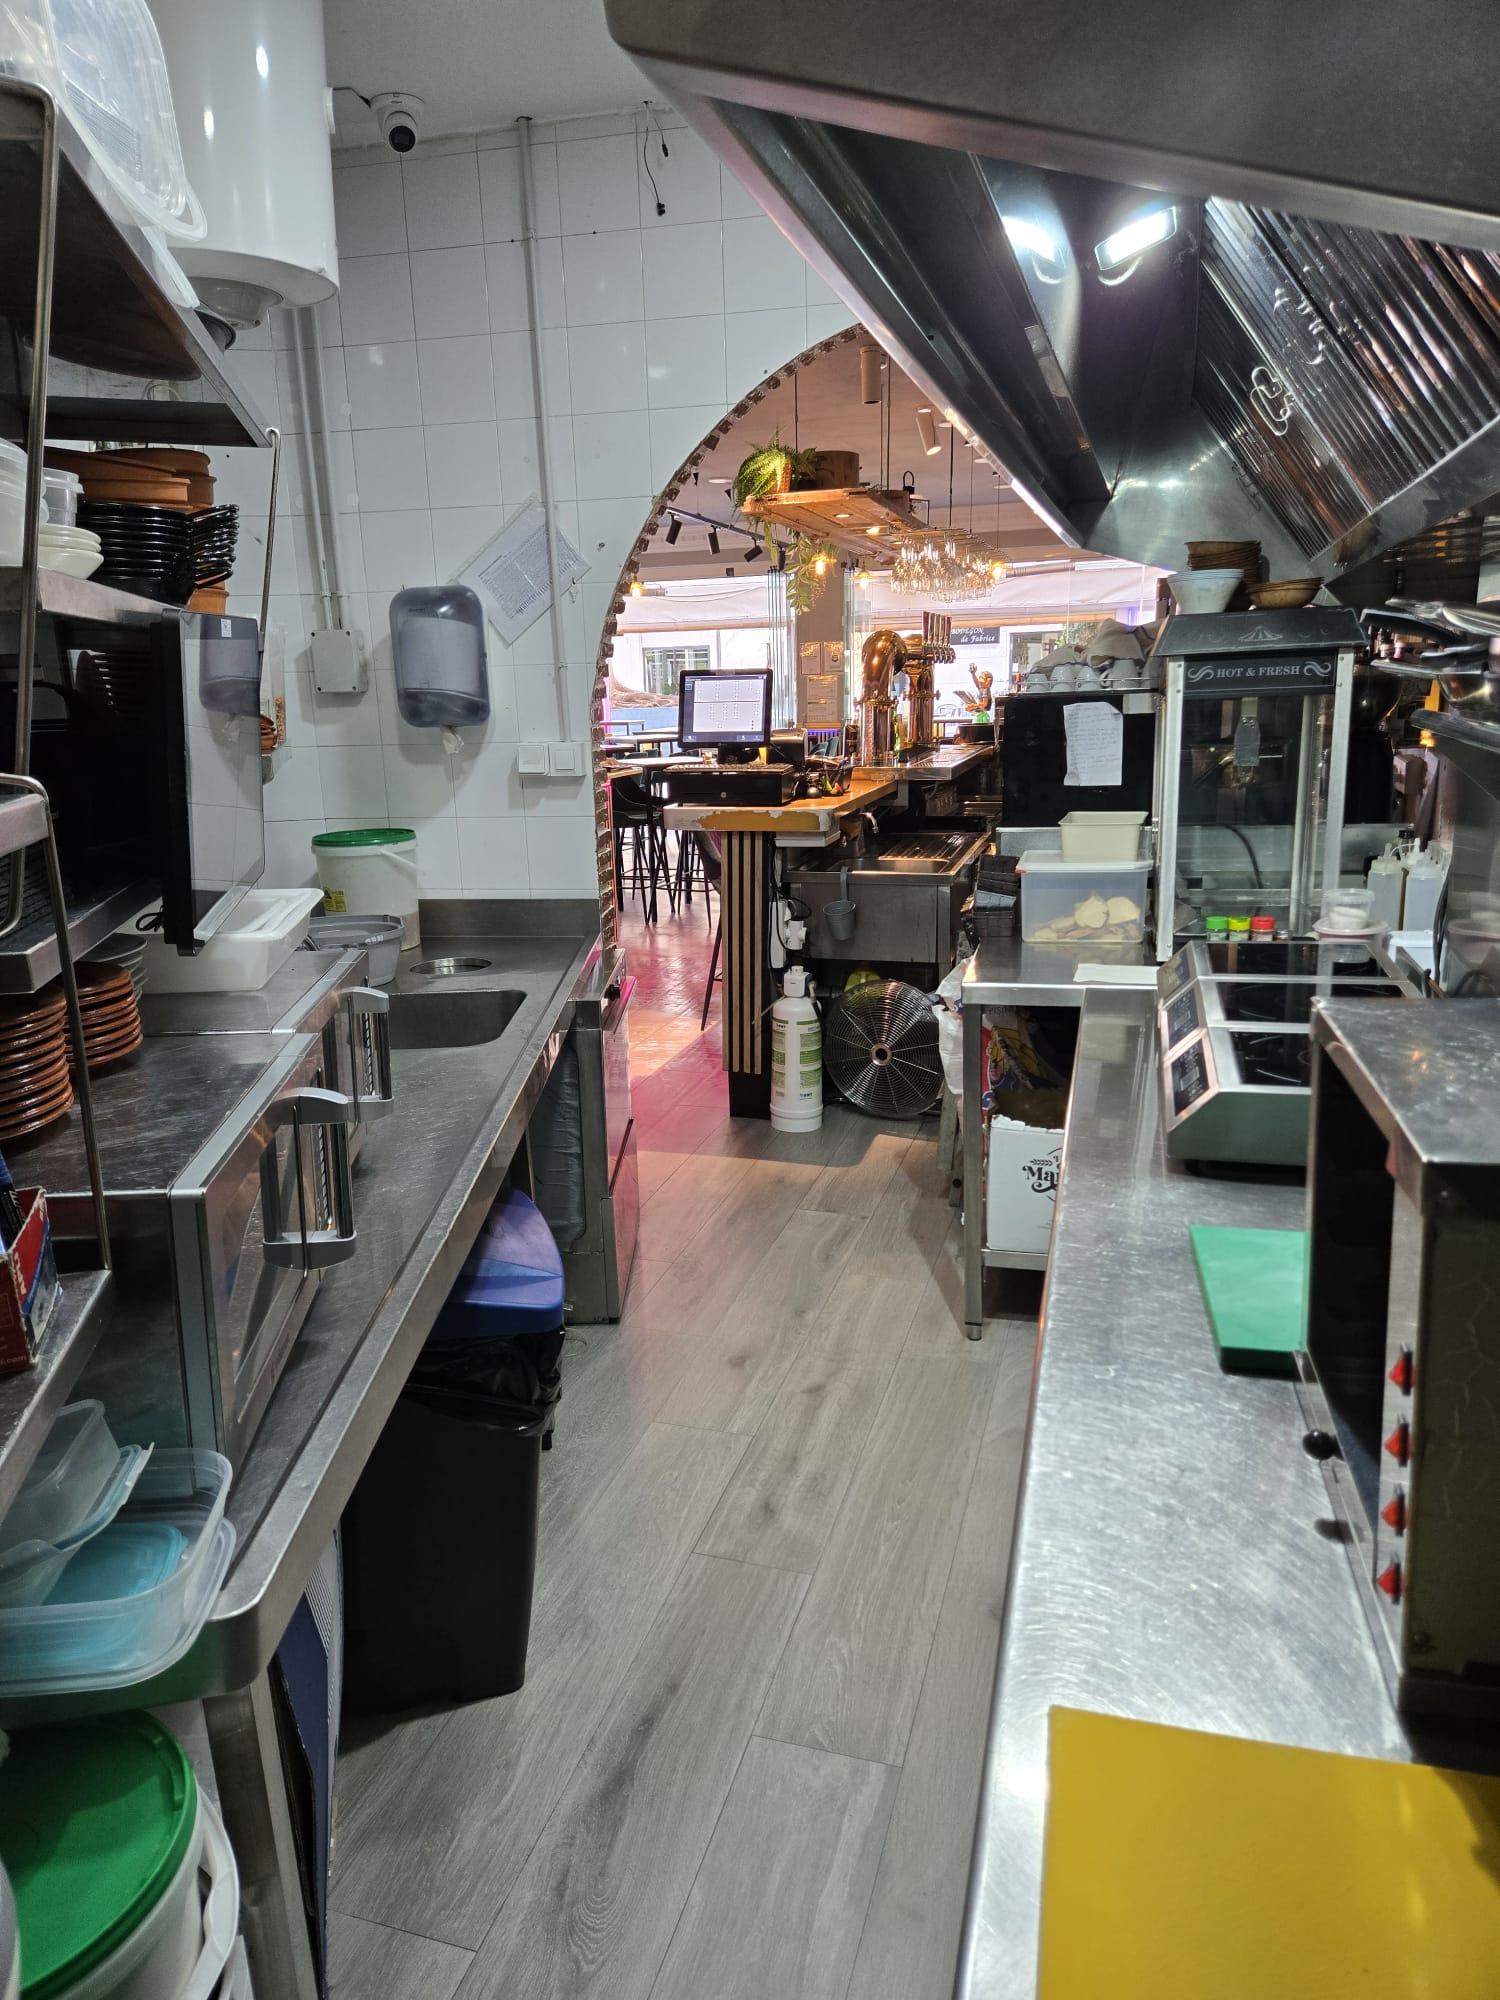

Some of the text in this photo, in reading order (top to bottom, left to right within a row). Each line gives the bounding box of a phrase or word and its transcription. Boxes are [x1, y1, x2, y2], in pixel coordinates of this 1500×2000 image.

[960, 635, 969, 643] de
[1216, 665, 1300, 678] HOT & FRESH
